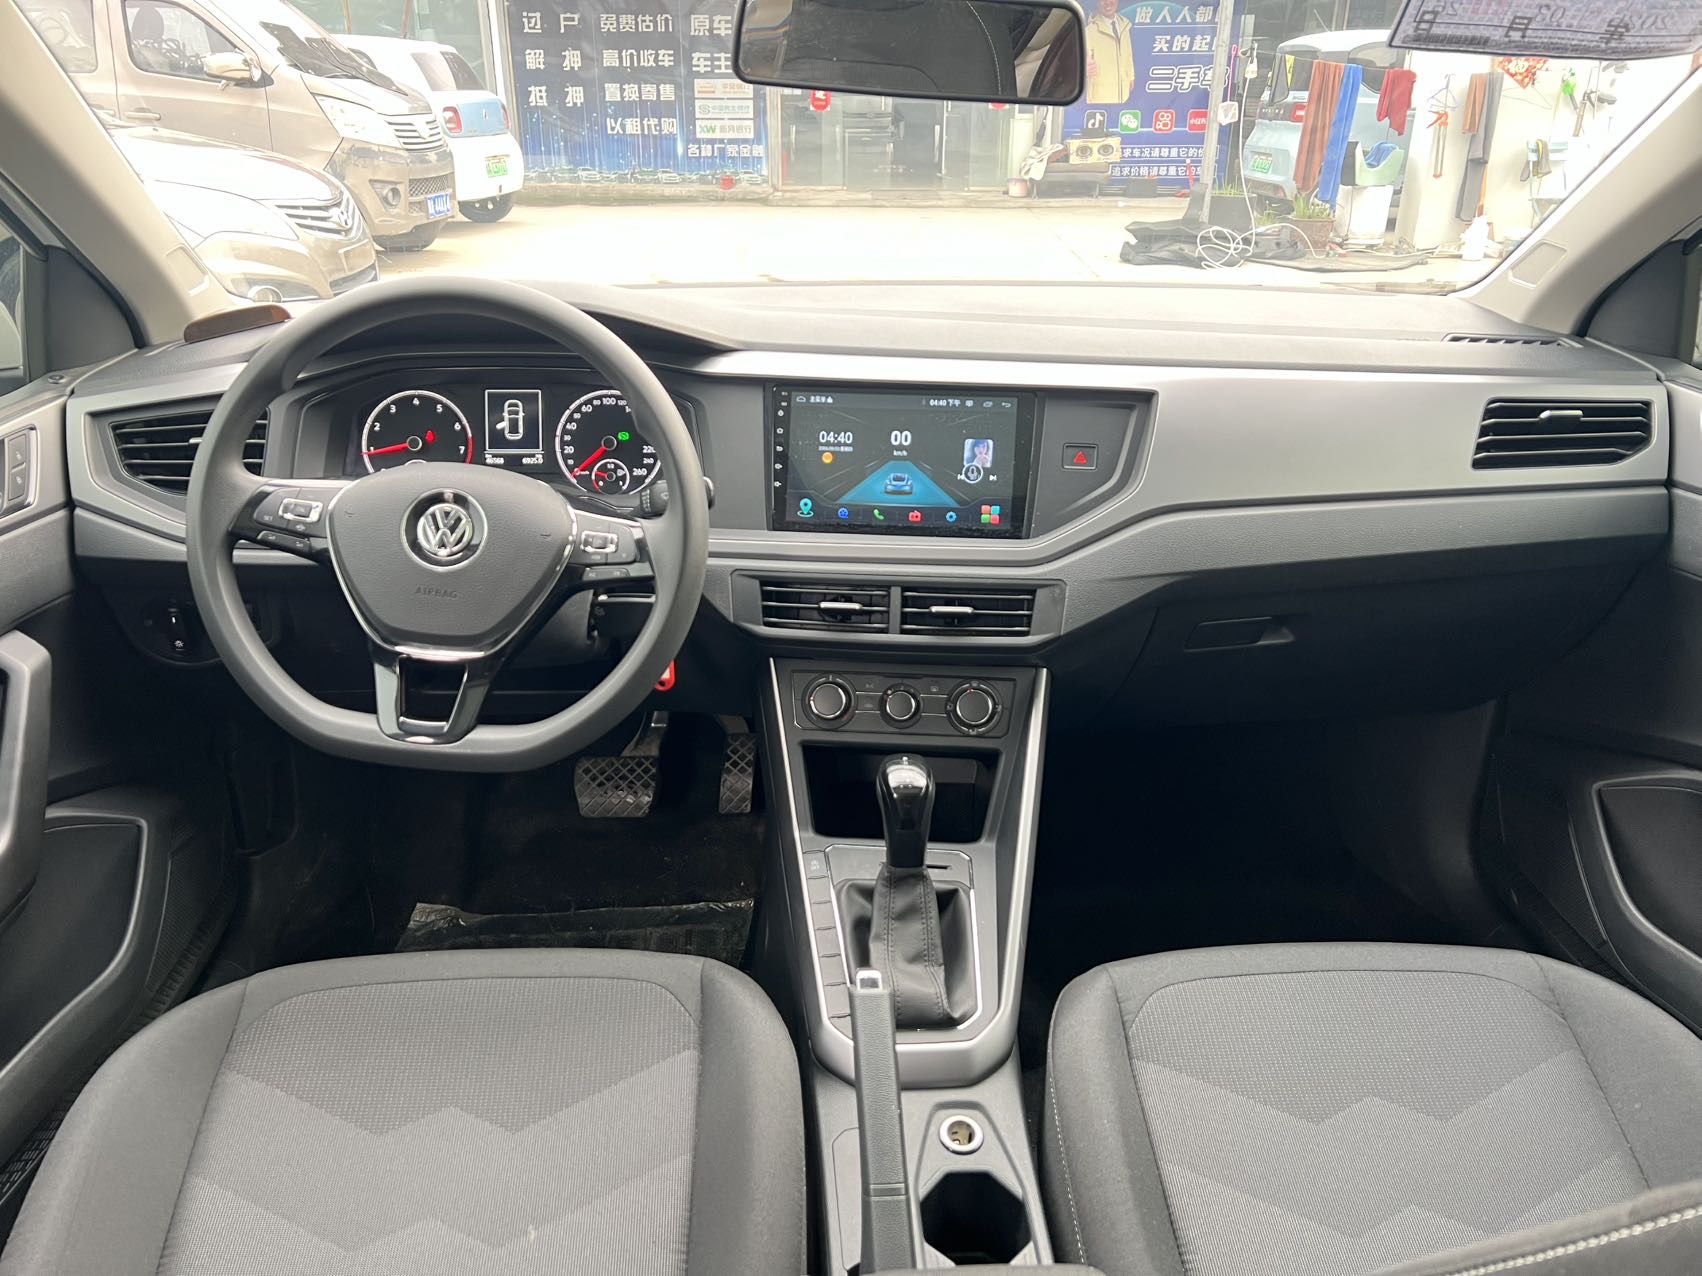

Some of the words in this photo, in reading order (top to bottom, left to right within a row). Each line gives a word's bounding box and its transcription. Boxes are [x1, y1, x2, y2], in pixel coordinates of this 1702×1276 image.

[1134, 6, 1219, 23] 做人人都
[600, 14, 673, 32] 免费估价
[1152, 35, 1216, 52] 买的起
[602, 49, 675, 67] 高价收车
[604, 83, 675, 101] 置换寄售
[606, 117, 677, 135] 以租代购
[1120, 147, 1204, 158] 求车况请尊重它的价
[412, 397, 420, 405] 4
[602, 397, 617, 405] 100
[389, 404, 397, 413] 3
[436, 404, 443, 412] 5
[581, 404, 593, 413] 60
[374, 422, 381, 431] 2
[454, 421, 462, 430] 6
[565, 422, 577, 430] 40
[819, 431, 853, 443] 04:40
[890, 430, 912, 446] 00
[458, 445, 466, 455] 7
[563, 445, 575, 454] 20
[632, 468, 648, 476] 260
[415, 586, 458, 599] AIRBAG
